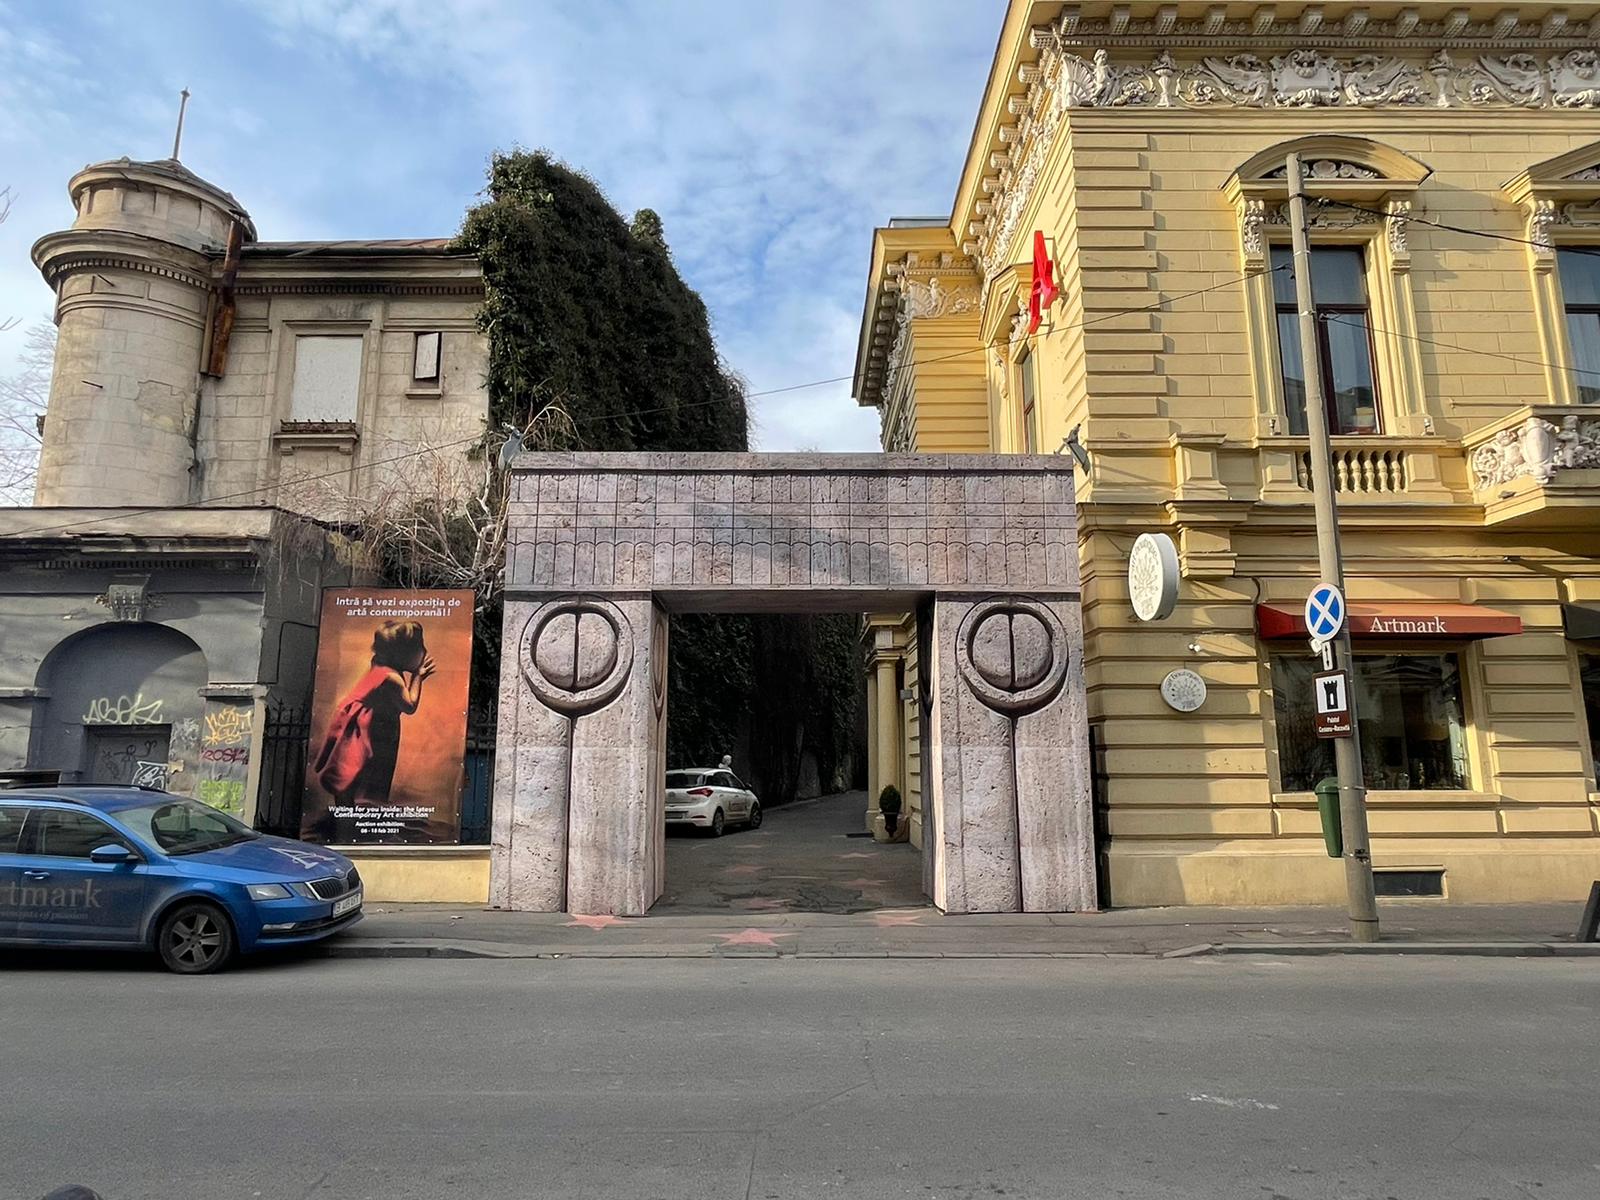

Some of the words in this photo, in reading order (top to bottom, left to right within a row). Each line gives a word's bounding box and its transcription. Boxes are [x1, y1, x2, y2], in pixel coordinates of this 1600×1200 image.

[336, 597, 360, 606] Intră
[362, 597, 373, 606] să
[376, 597, 396, 606] vezi
[399, 597, 445, 608] expoziția
[448, 597, 461, 606] de
[1369, 616, 1448, 633] Artmark
